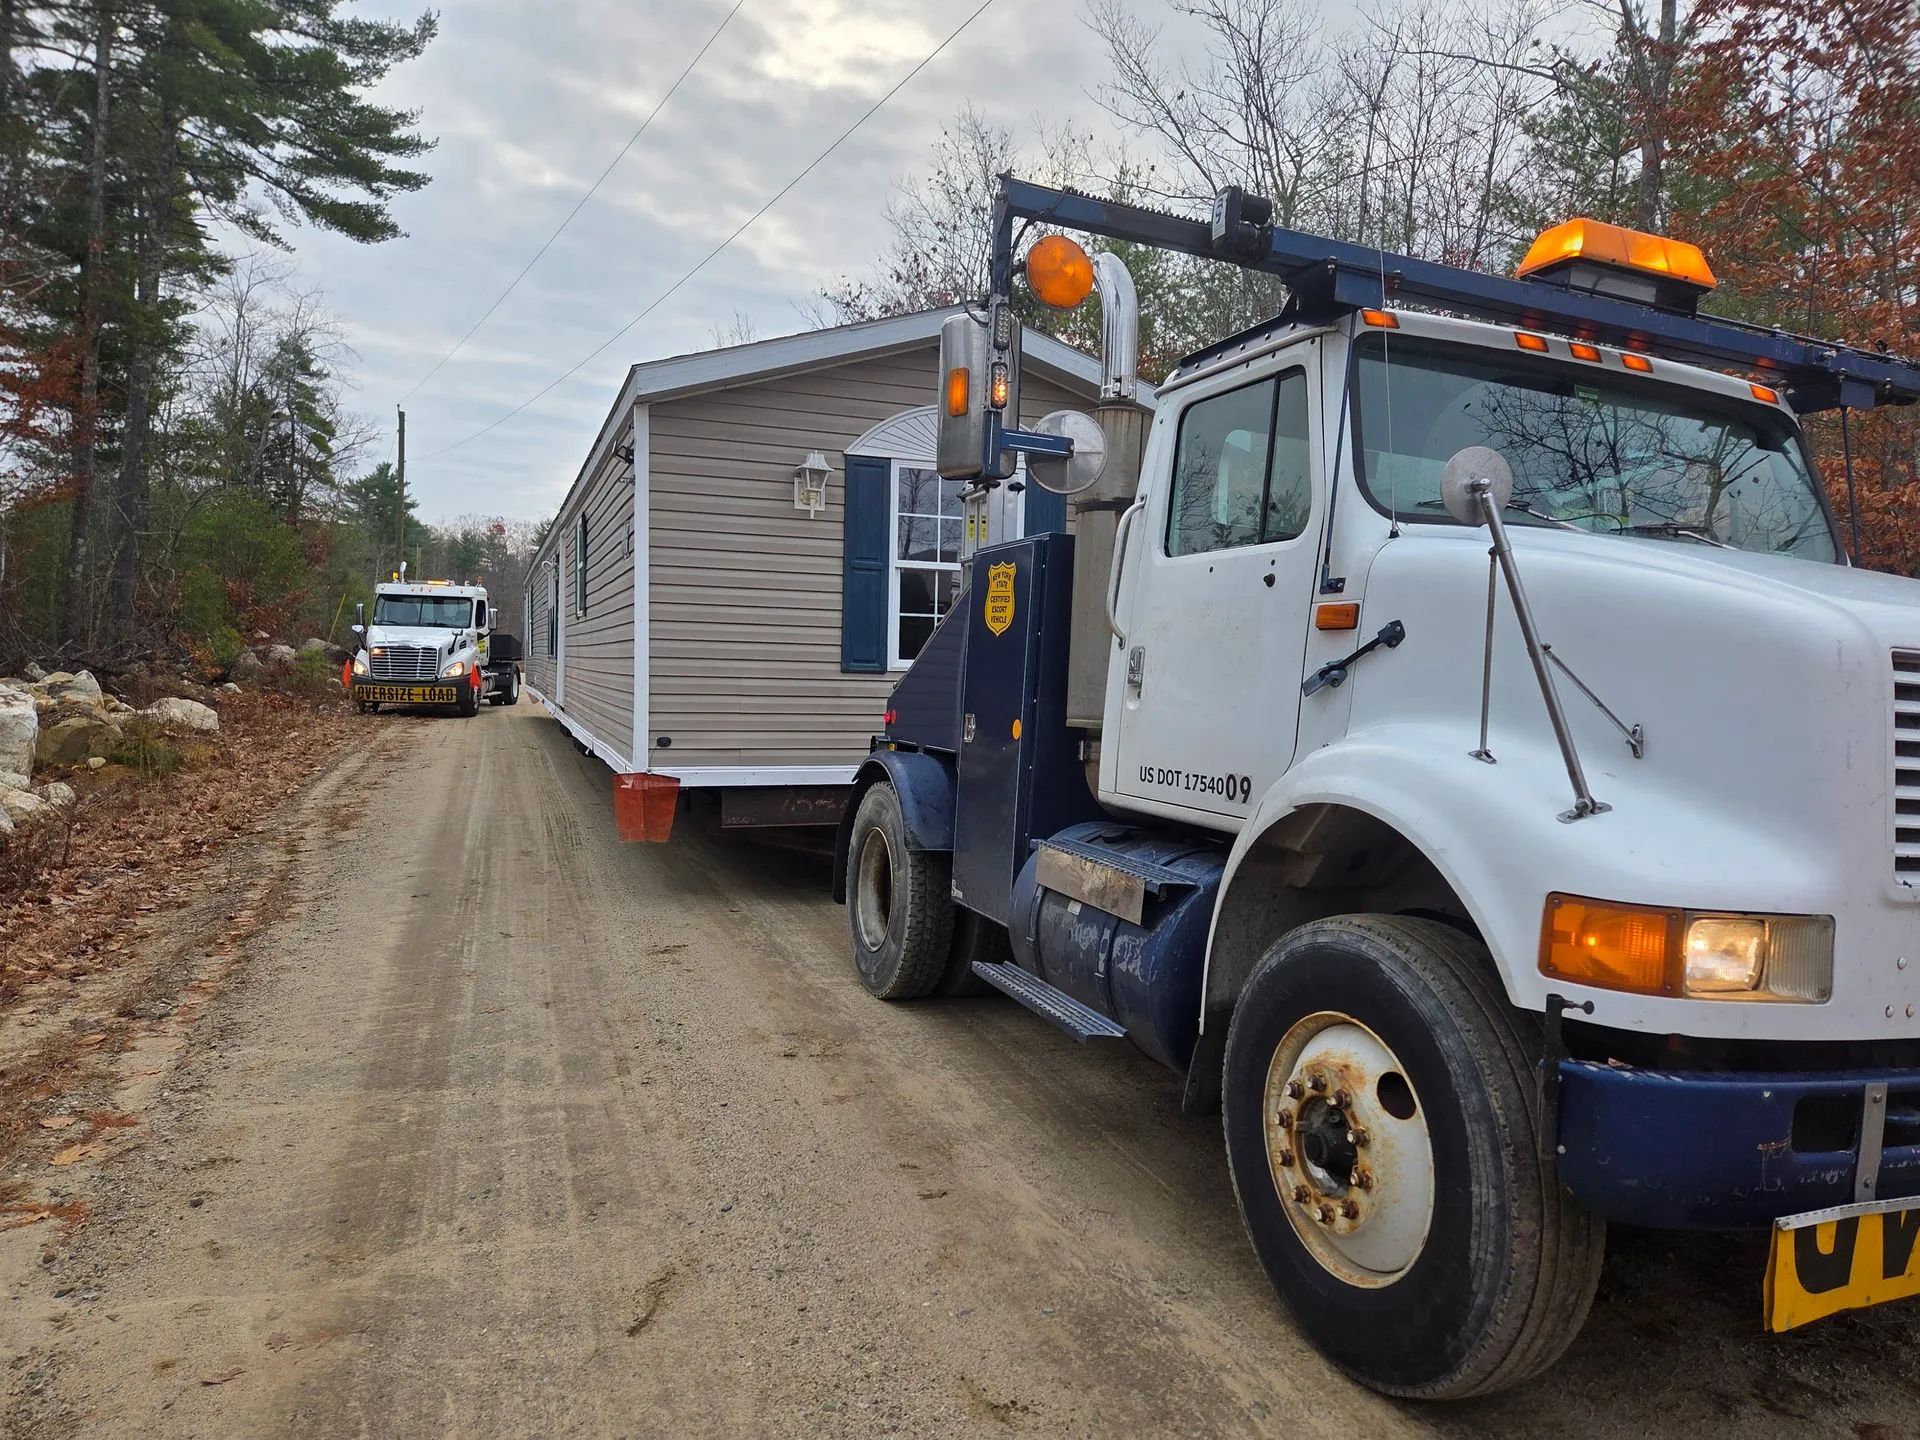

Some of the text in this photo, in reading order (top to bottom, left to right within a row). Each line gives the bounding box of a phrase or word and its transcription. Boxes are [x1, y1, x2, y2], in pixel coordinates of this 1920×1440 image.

[992, 571, 1012, 581] NEW YORK
[996, 580, 1008, 589] STATE
[992, 605, 1007, 613] ESCORT
[357, 686, 454, 702] OVERSIZE LOAD
[1139, 766, 1252, 804] US DOT 1754009
